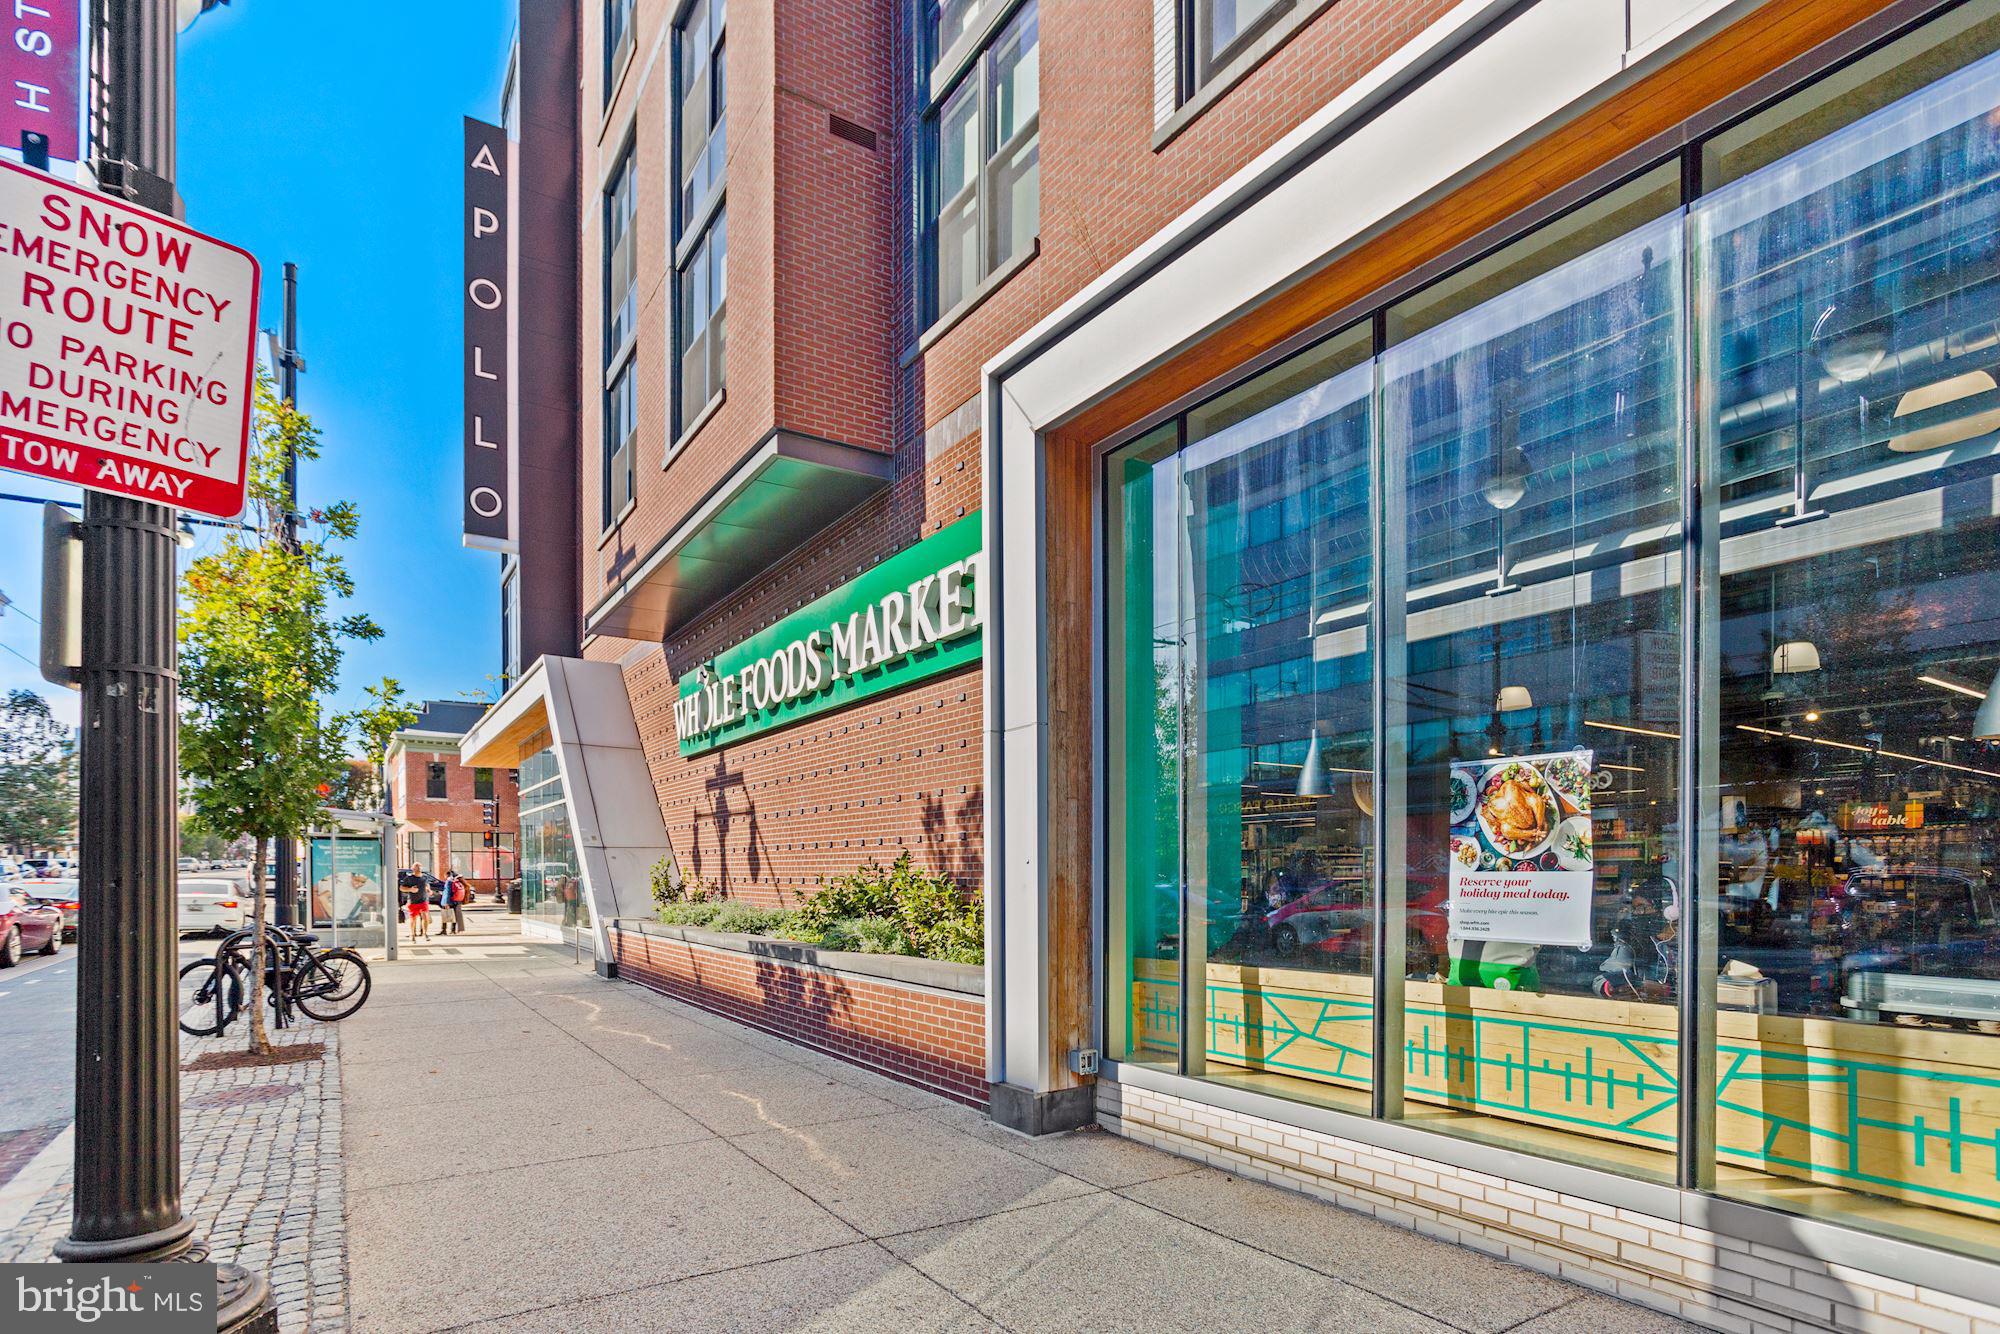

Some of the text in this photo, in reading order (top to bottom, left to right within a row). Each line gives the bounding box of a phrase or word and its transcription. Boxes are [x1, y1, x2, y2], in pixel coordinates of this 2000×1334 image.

[14, 0, 52, 113] H ST
[0, 222, 231, 323] MERGENCY
[40, 194, 192, 274] SNOW
[23, 271, 194, 357] ROUTE
[468, 143, 503, 519] APOLLO
[0, 317, 228, 406] O PARKING
[29, 361, 180, 425] DURING
[0, 390, 221, 469] MERGENCY
[1, 434, 194, 499] TOW AWAY
[673, 663, 735, 742] WHOLE
[740, 629, 823, 716] FOODS
[1851, 806, 1878, 817] Joy
[1872, 814, 1909, 826] table
[1459, 877, 1532, 889] Reserve your
[1459, 888, 1570, 901] holiday meal today.
